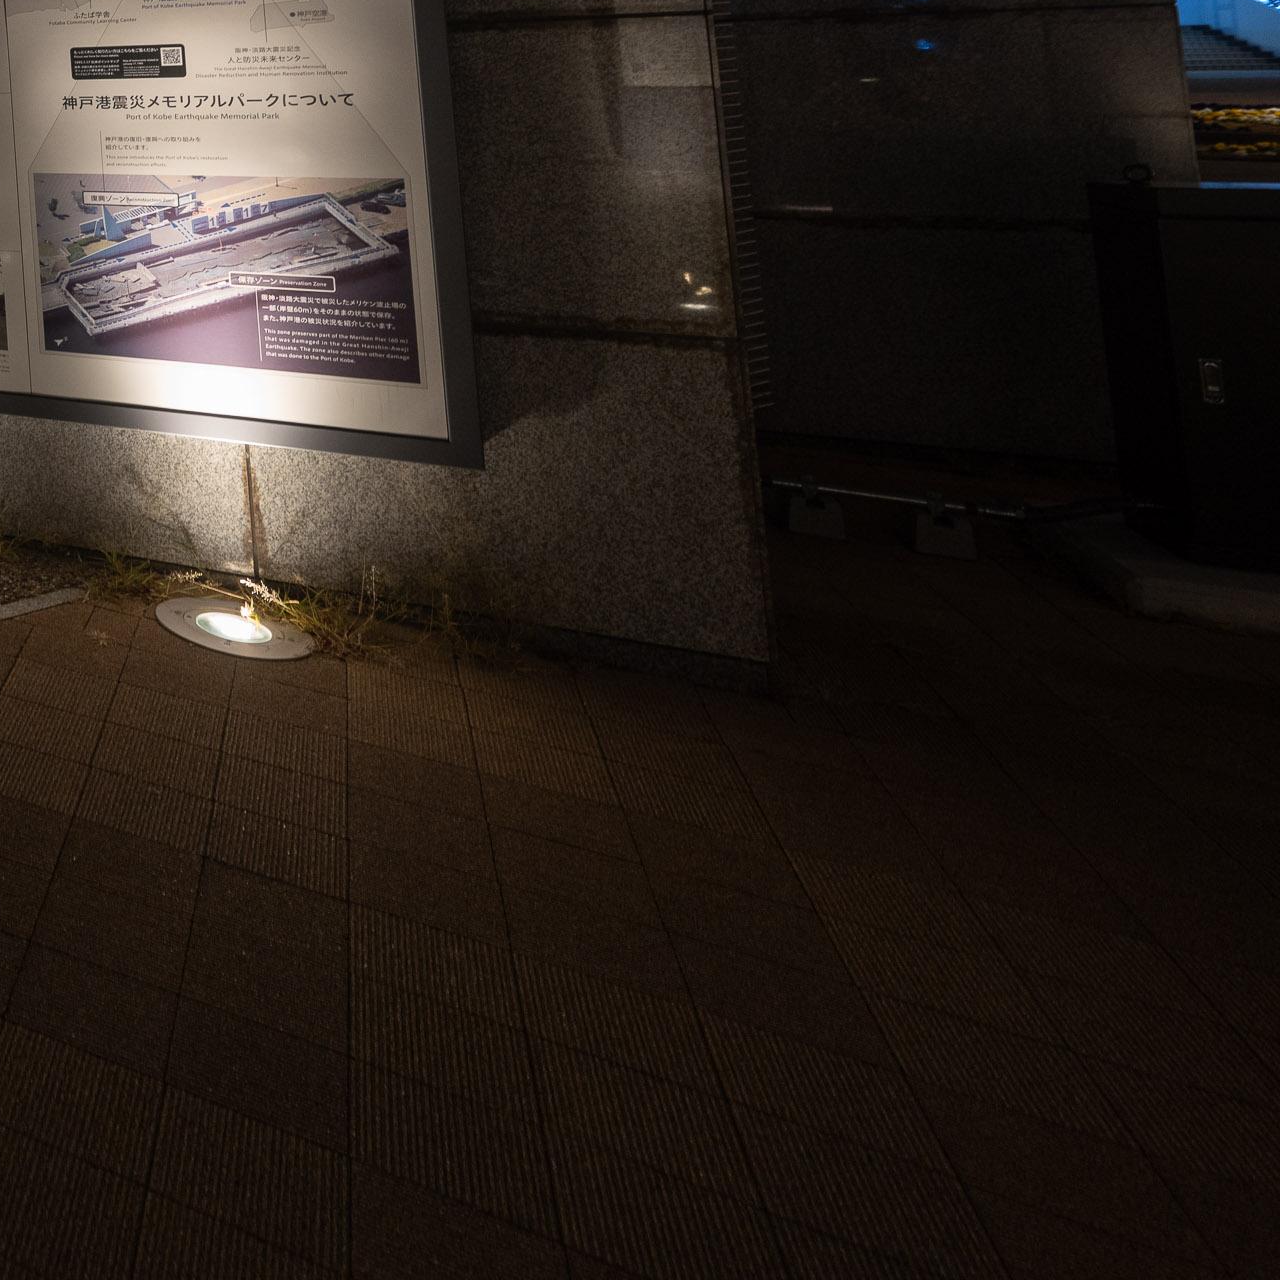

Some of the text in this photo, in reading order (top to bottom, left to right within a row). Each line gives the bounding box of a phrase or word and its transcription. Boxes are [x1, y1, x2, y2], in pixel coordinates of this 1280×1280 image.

[74, 12, 110, 20] ふたば学舎
[228, 56, 310, 64] 人と防災未来センター
[62, 93, 355, 110] 神戸港震災メモリアルパークについて
[174, 113, 219, 121] Earthquake
[220, 112, 260, 120] Memorial
[238, 276, 277, 285] 保存ゾーン
[261, 294, 406, 310] 阪神・淡路大震災で被災したメリケン波止場の
[263, 315, 396, 330] また、神戸港の被災状況を紹介しています。
[292, 338, 320, 346] damaged
[362, 343, 409, 352] Hanshin-Awaji
